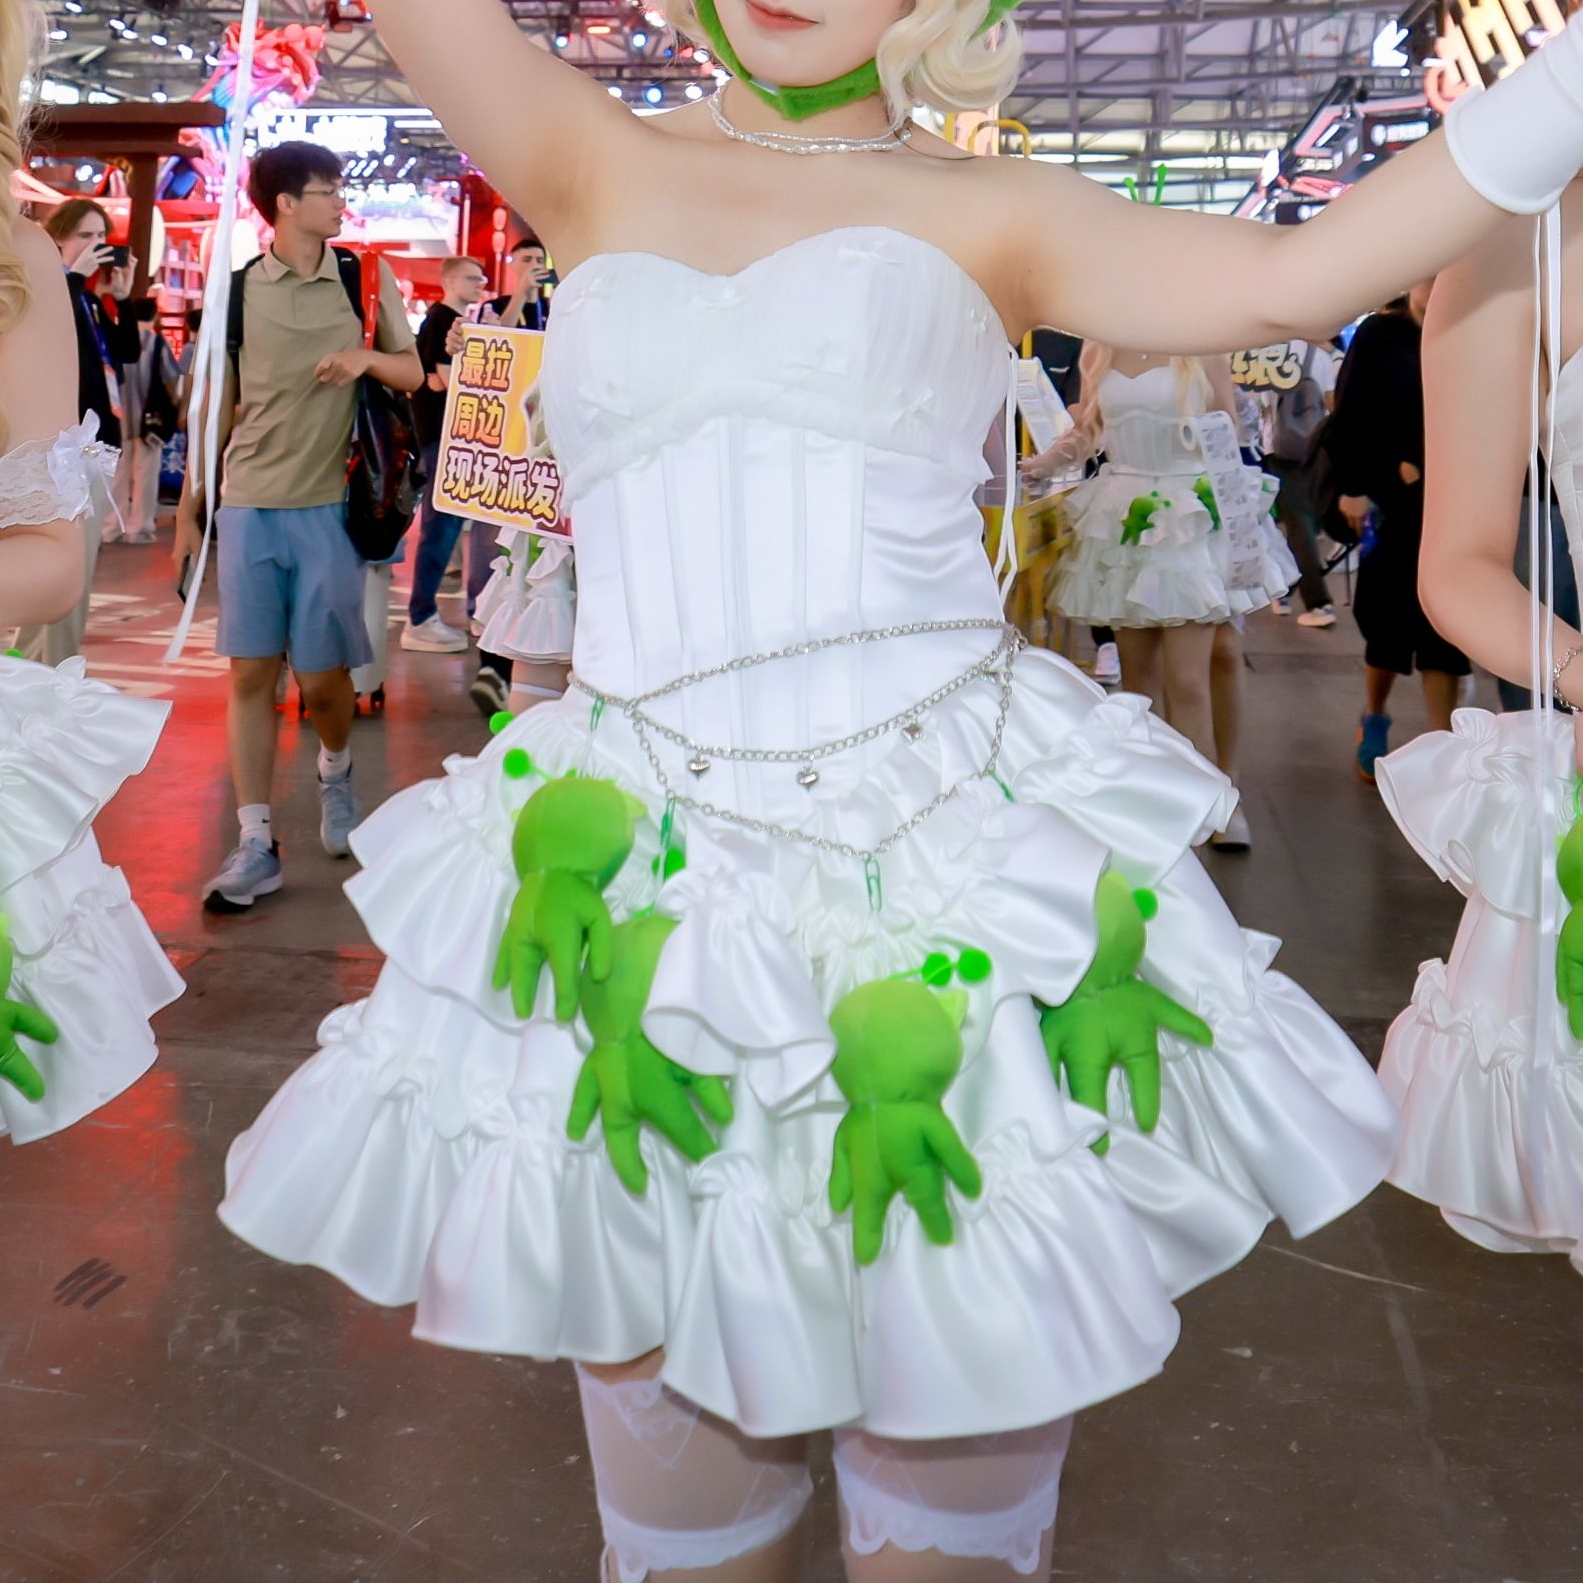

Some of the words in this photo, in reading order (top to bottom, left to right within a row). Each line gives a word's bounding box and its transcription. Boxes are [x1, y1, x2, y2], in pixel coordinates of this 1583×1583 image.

[458, 338, 513, 391] 最拉
[450, 391, 505, 448] 周边
[443, 445, 560, 522] 现场派发
